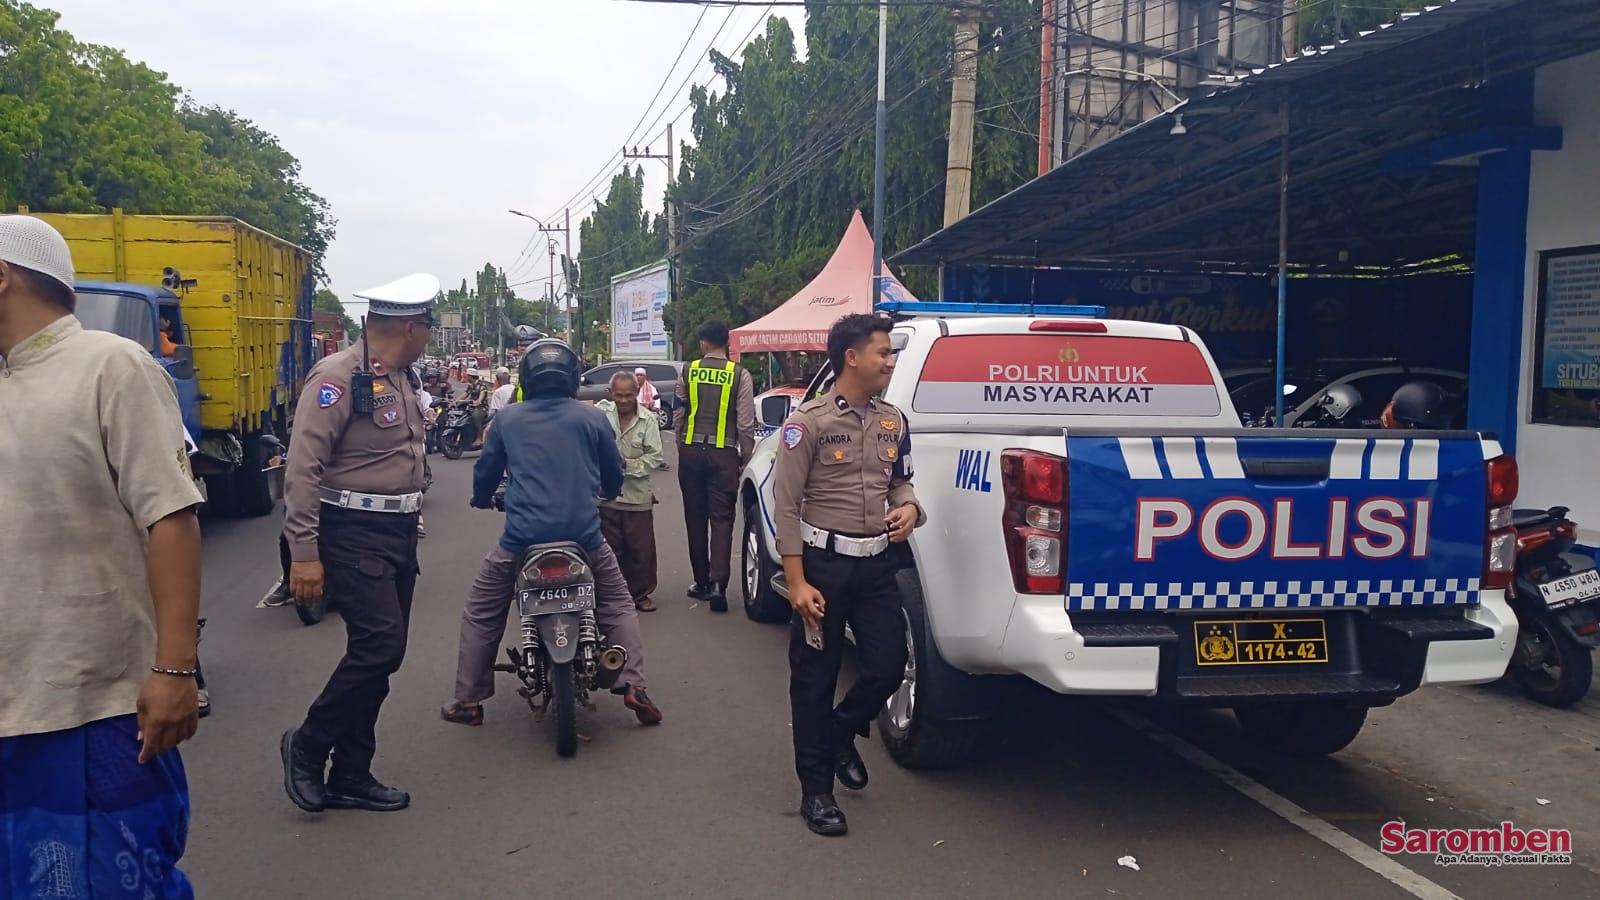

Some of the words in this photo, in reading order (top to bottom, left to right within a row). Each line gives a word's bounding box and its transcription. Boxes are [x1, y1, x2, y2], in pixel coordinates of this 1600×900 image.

[808, 296, 835, 306] jatim
[740, 335, 758, 346] BANK
[780, 332, 807, 344] CABANG
[690, 369, 732, 385] POLISI
[989, 364, 1060, 382] POLRI
[1068, 366, 1149, 383] UNTUK
[1557, 363, 1600, 380] SITUB
[984, 385, 1153, 403] MASYARAKAT
[819, 433, 852, 446] CANDRA
[955, 449, 992, 493] WAL
[1135, 496, 1432, 562] POLISI
[522, 592, 529, 602] P
[540, 588, 568, 600] 4640
[577, 586, 593, 597] DZ
[1554, 579, 1577, 593] 4650
[1272, 623, 1287, 639] X
